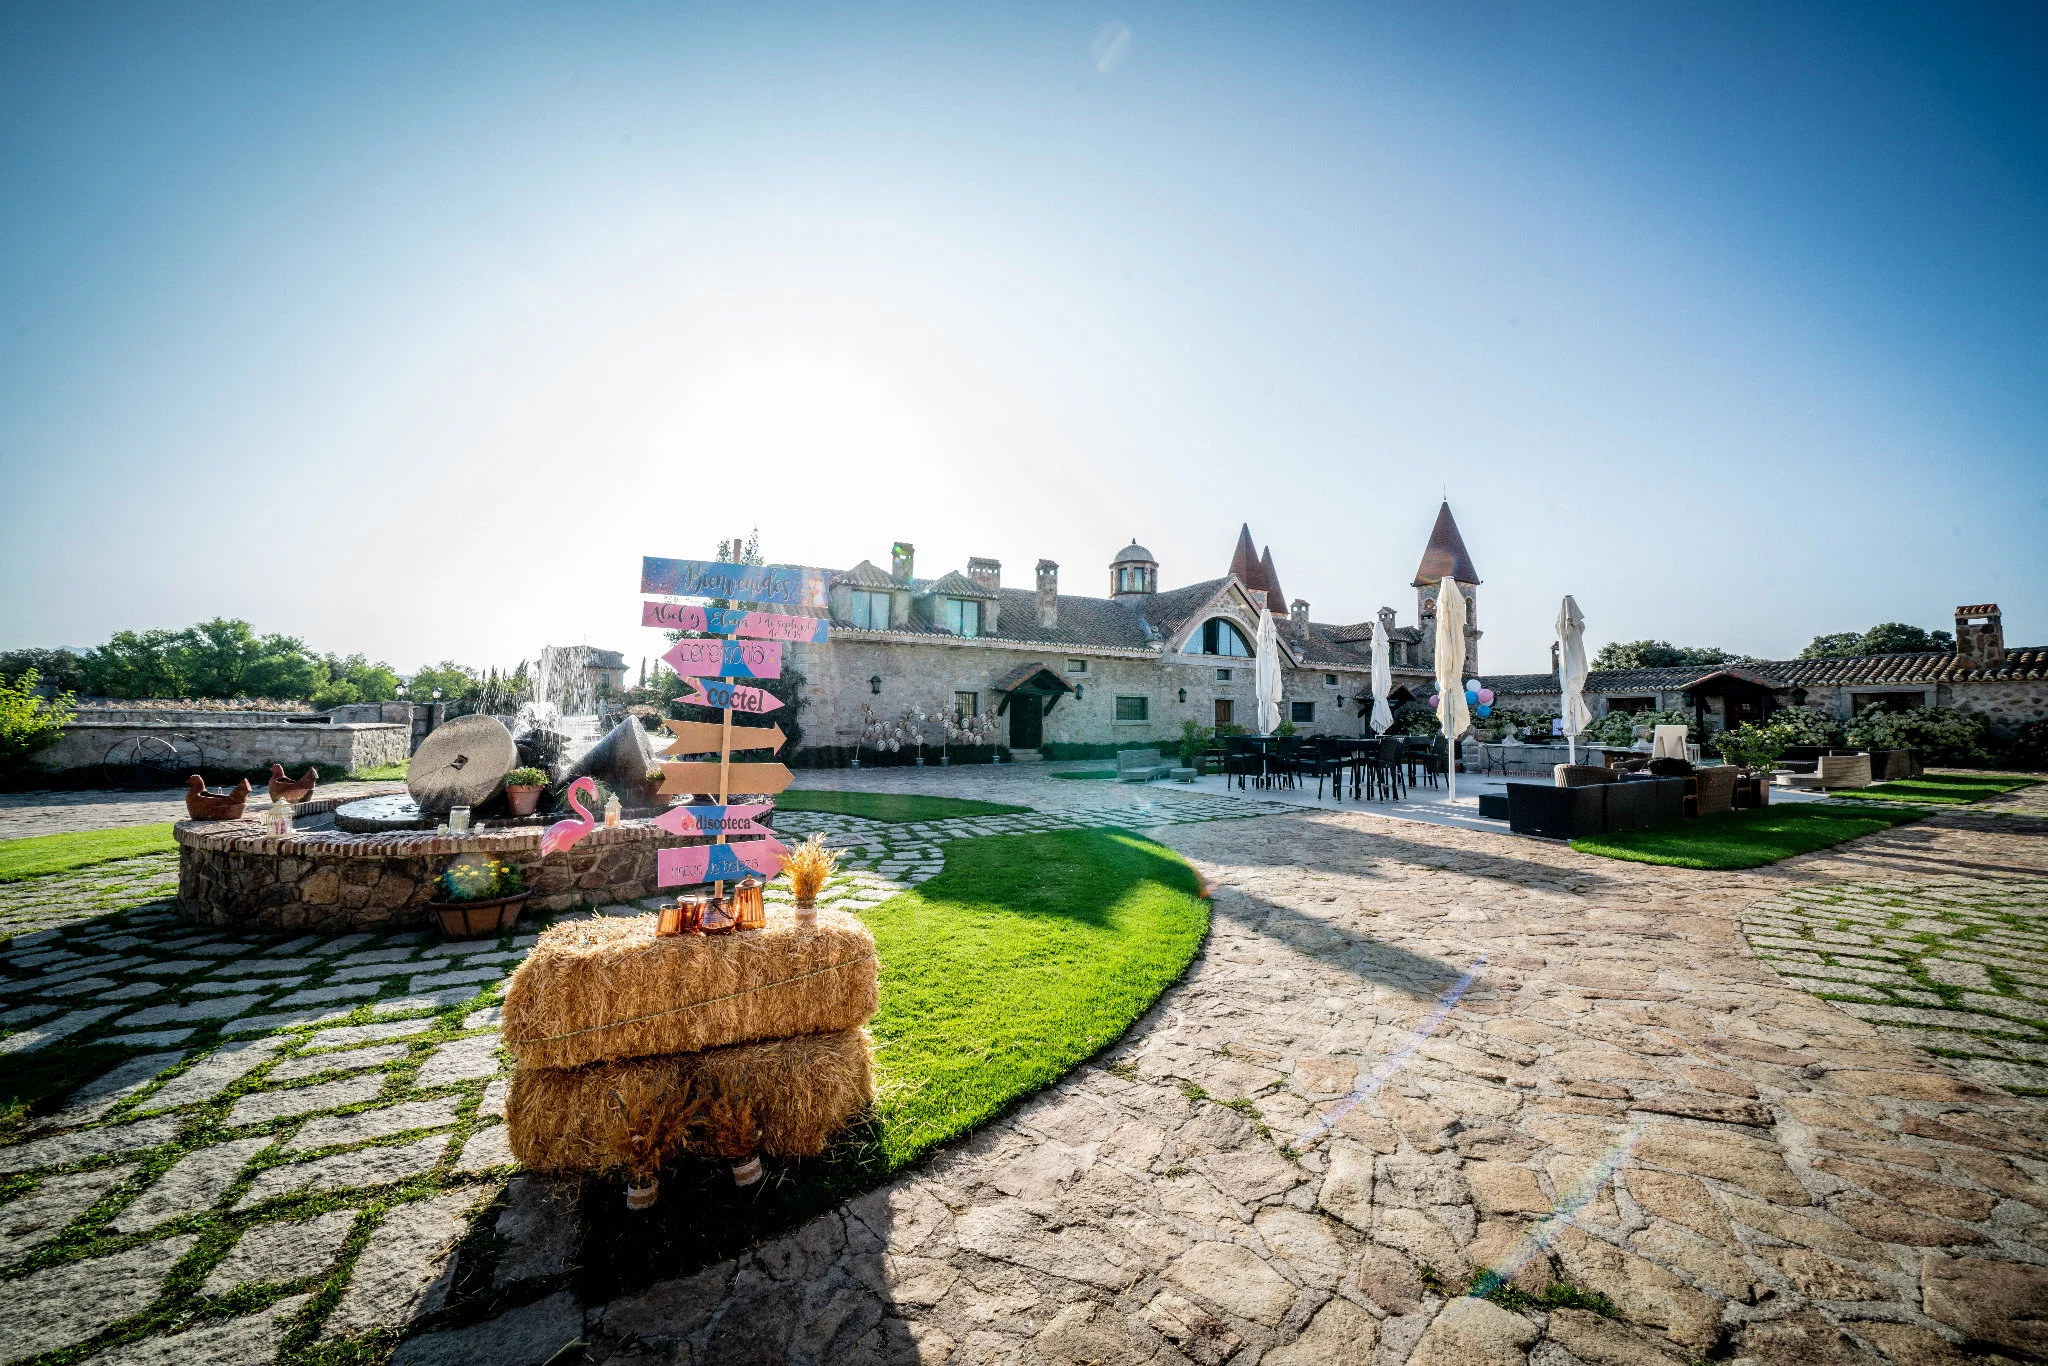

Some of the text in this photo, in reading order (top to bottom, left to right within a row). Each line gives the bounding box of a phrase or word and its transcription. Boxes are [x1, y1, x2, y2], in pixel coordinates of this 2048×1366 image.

[683, 562, 794, 602] Bienvenidos
[644, 603, 687, 624] Abel
[690, 613, 701, 629] y
[680, 643, 765, 665] ceremonia
[706, 687, 764, 712] coctel
[695, 814, 751, 831] discoteca
